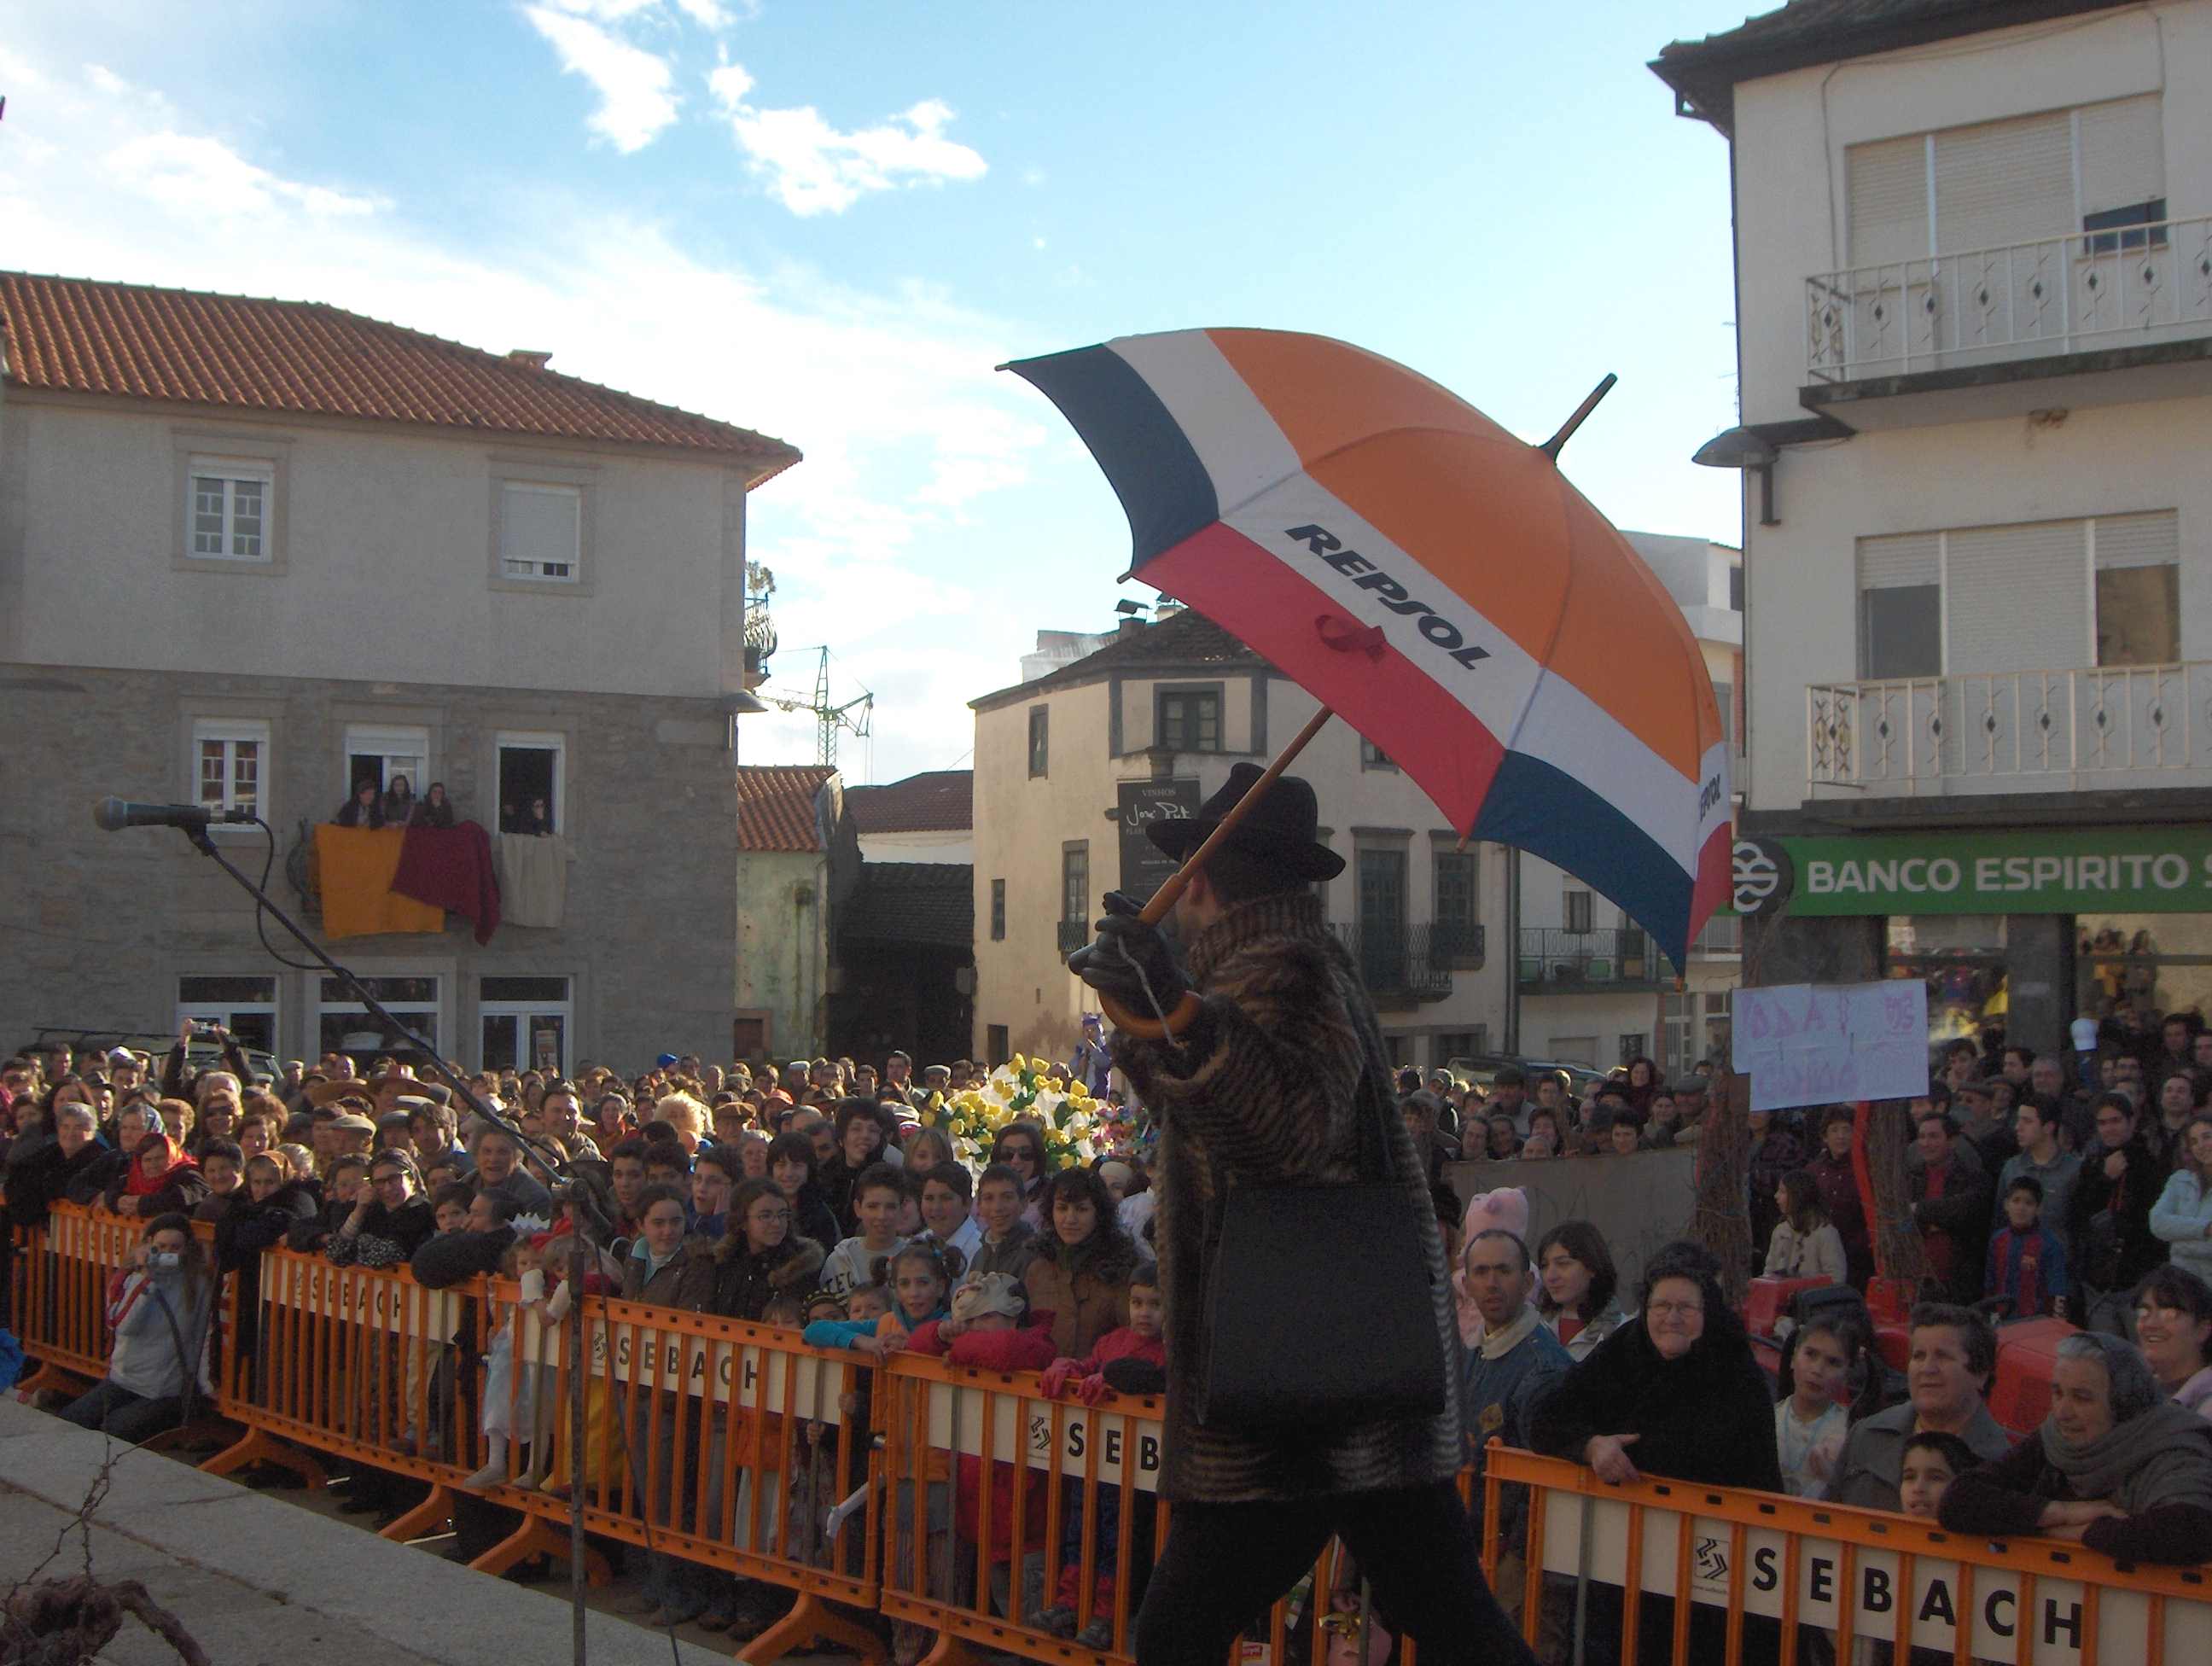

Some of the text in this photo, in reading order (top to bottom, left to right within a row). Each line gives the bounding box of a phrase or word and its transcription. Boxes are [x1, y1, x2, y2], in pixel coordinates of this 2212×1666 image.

[1284, 524, 1491, 670] REPSOL
[1142, 788, 1177, 797] VINHOS
[1807, 858, 1961, 894] BANCO
[1975, 853, 2191, 893] ESPIRITO
[619, 1337, 757, 1389] SEBACH
[1068, 1422, 1160, 1471] SEB
[1752, 1547, 2082, 1649] SEBACH
